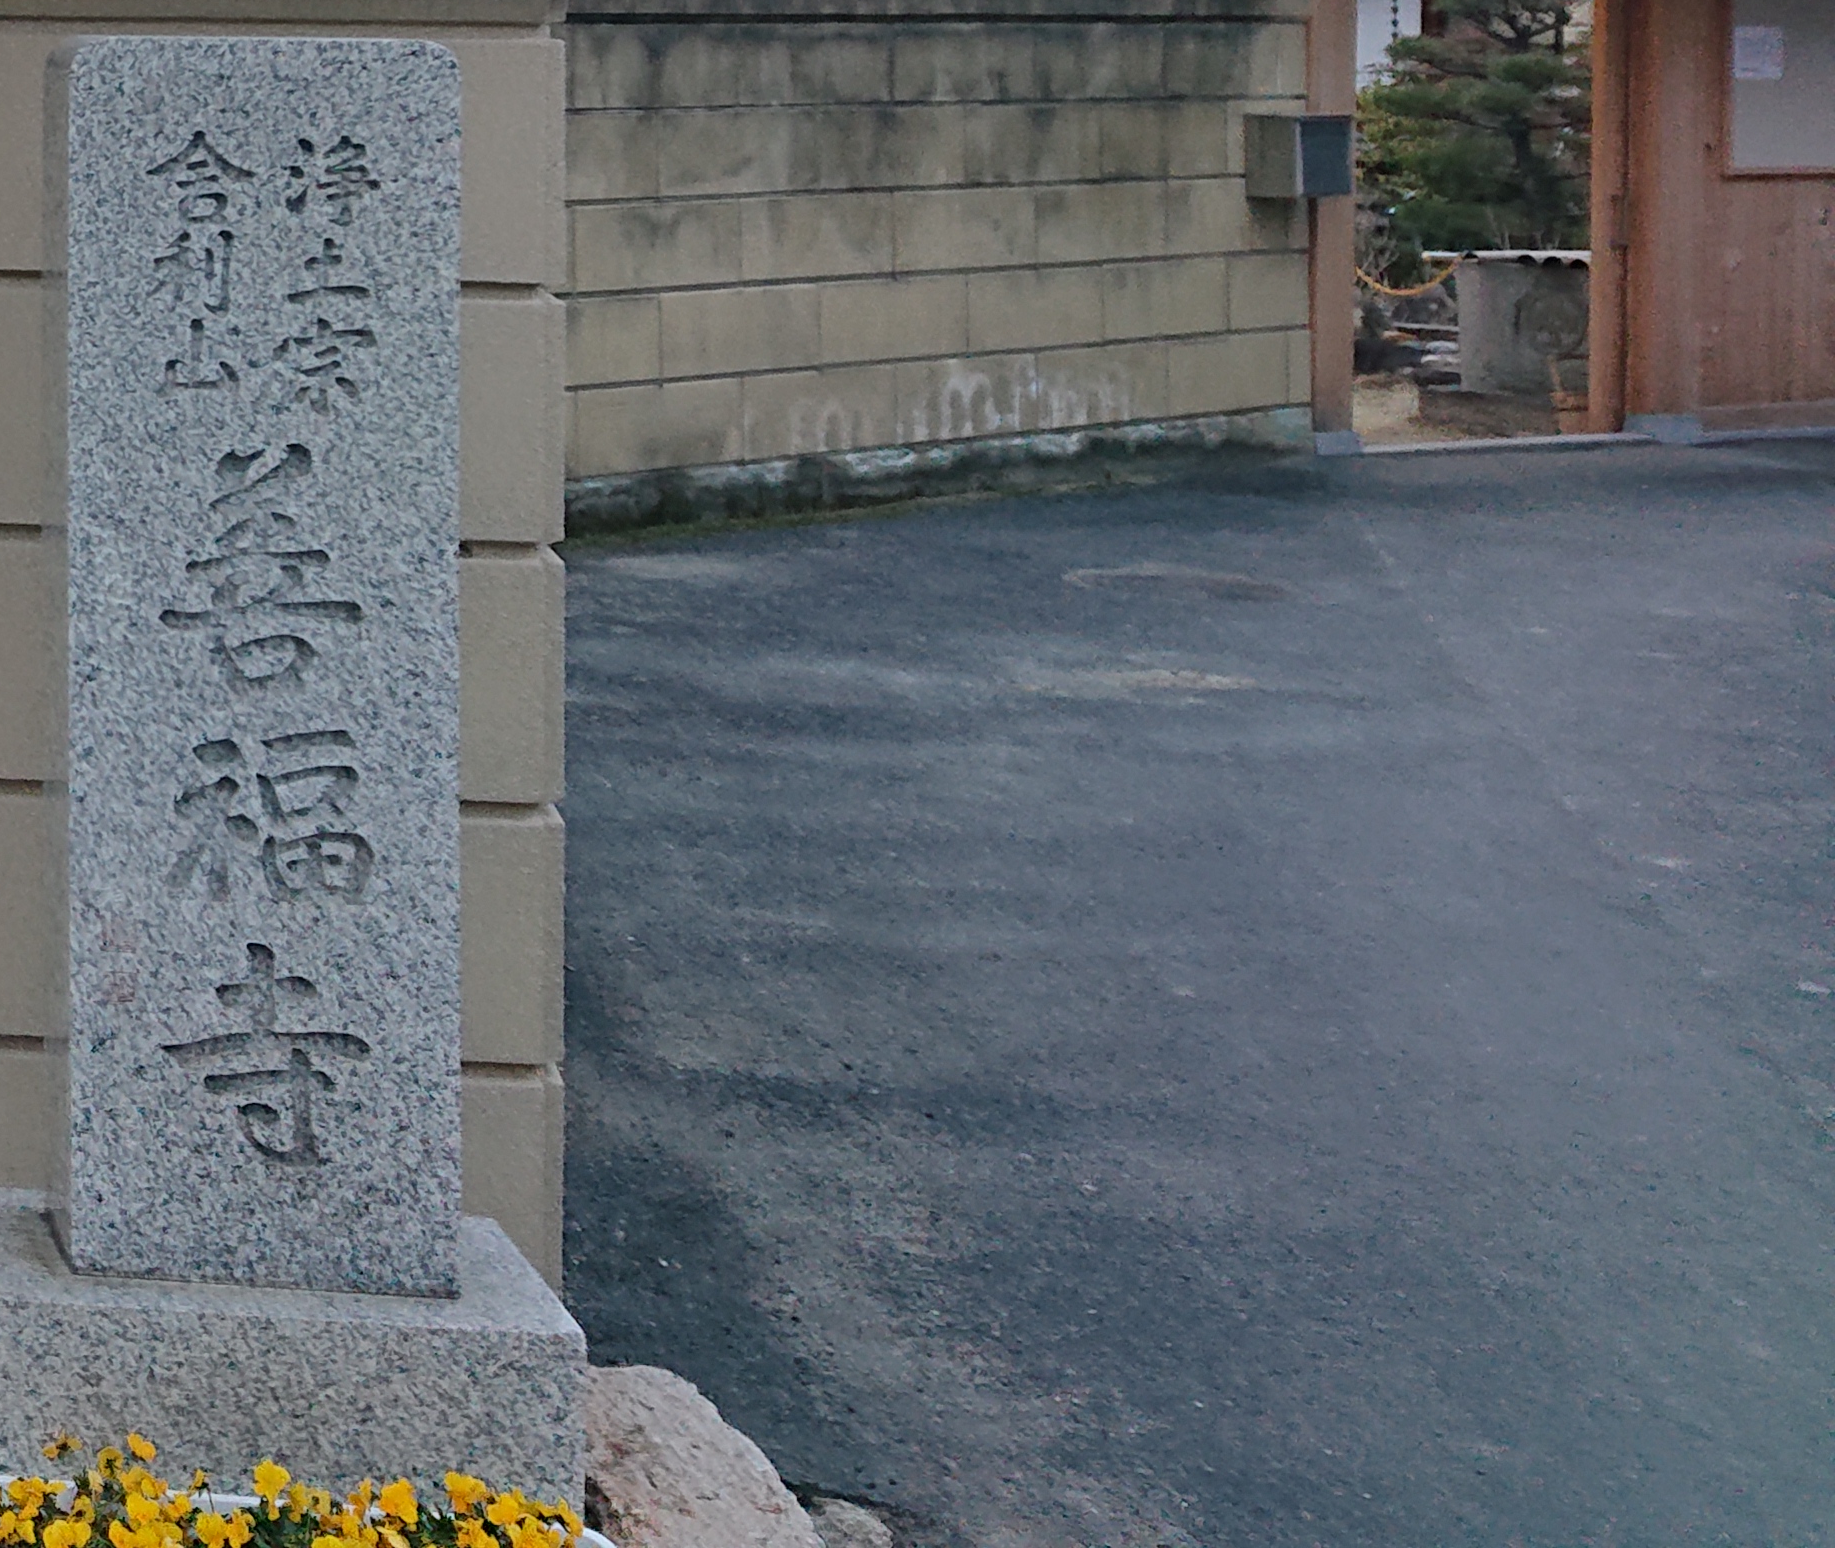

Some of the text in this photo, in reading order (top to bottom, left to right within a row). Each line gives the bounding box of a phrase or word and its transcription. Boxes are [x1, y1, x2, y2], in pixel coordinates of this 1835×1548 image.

[273, 134, 380, 415] 浄土宗
[159, 443, 374, 1164] 善福寺
